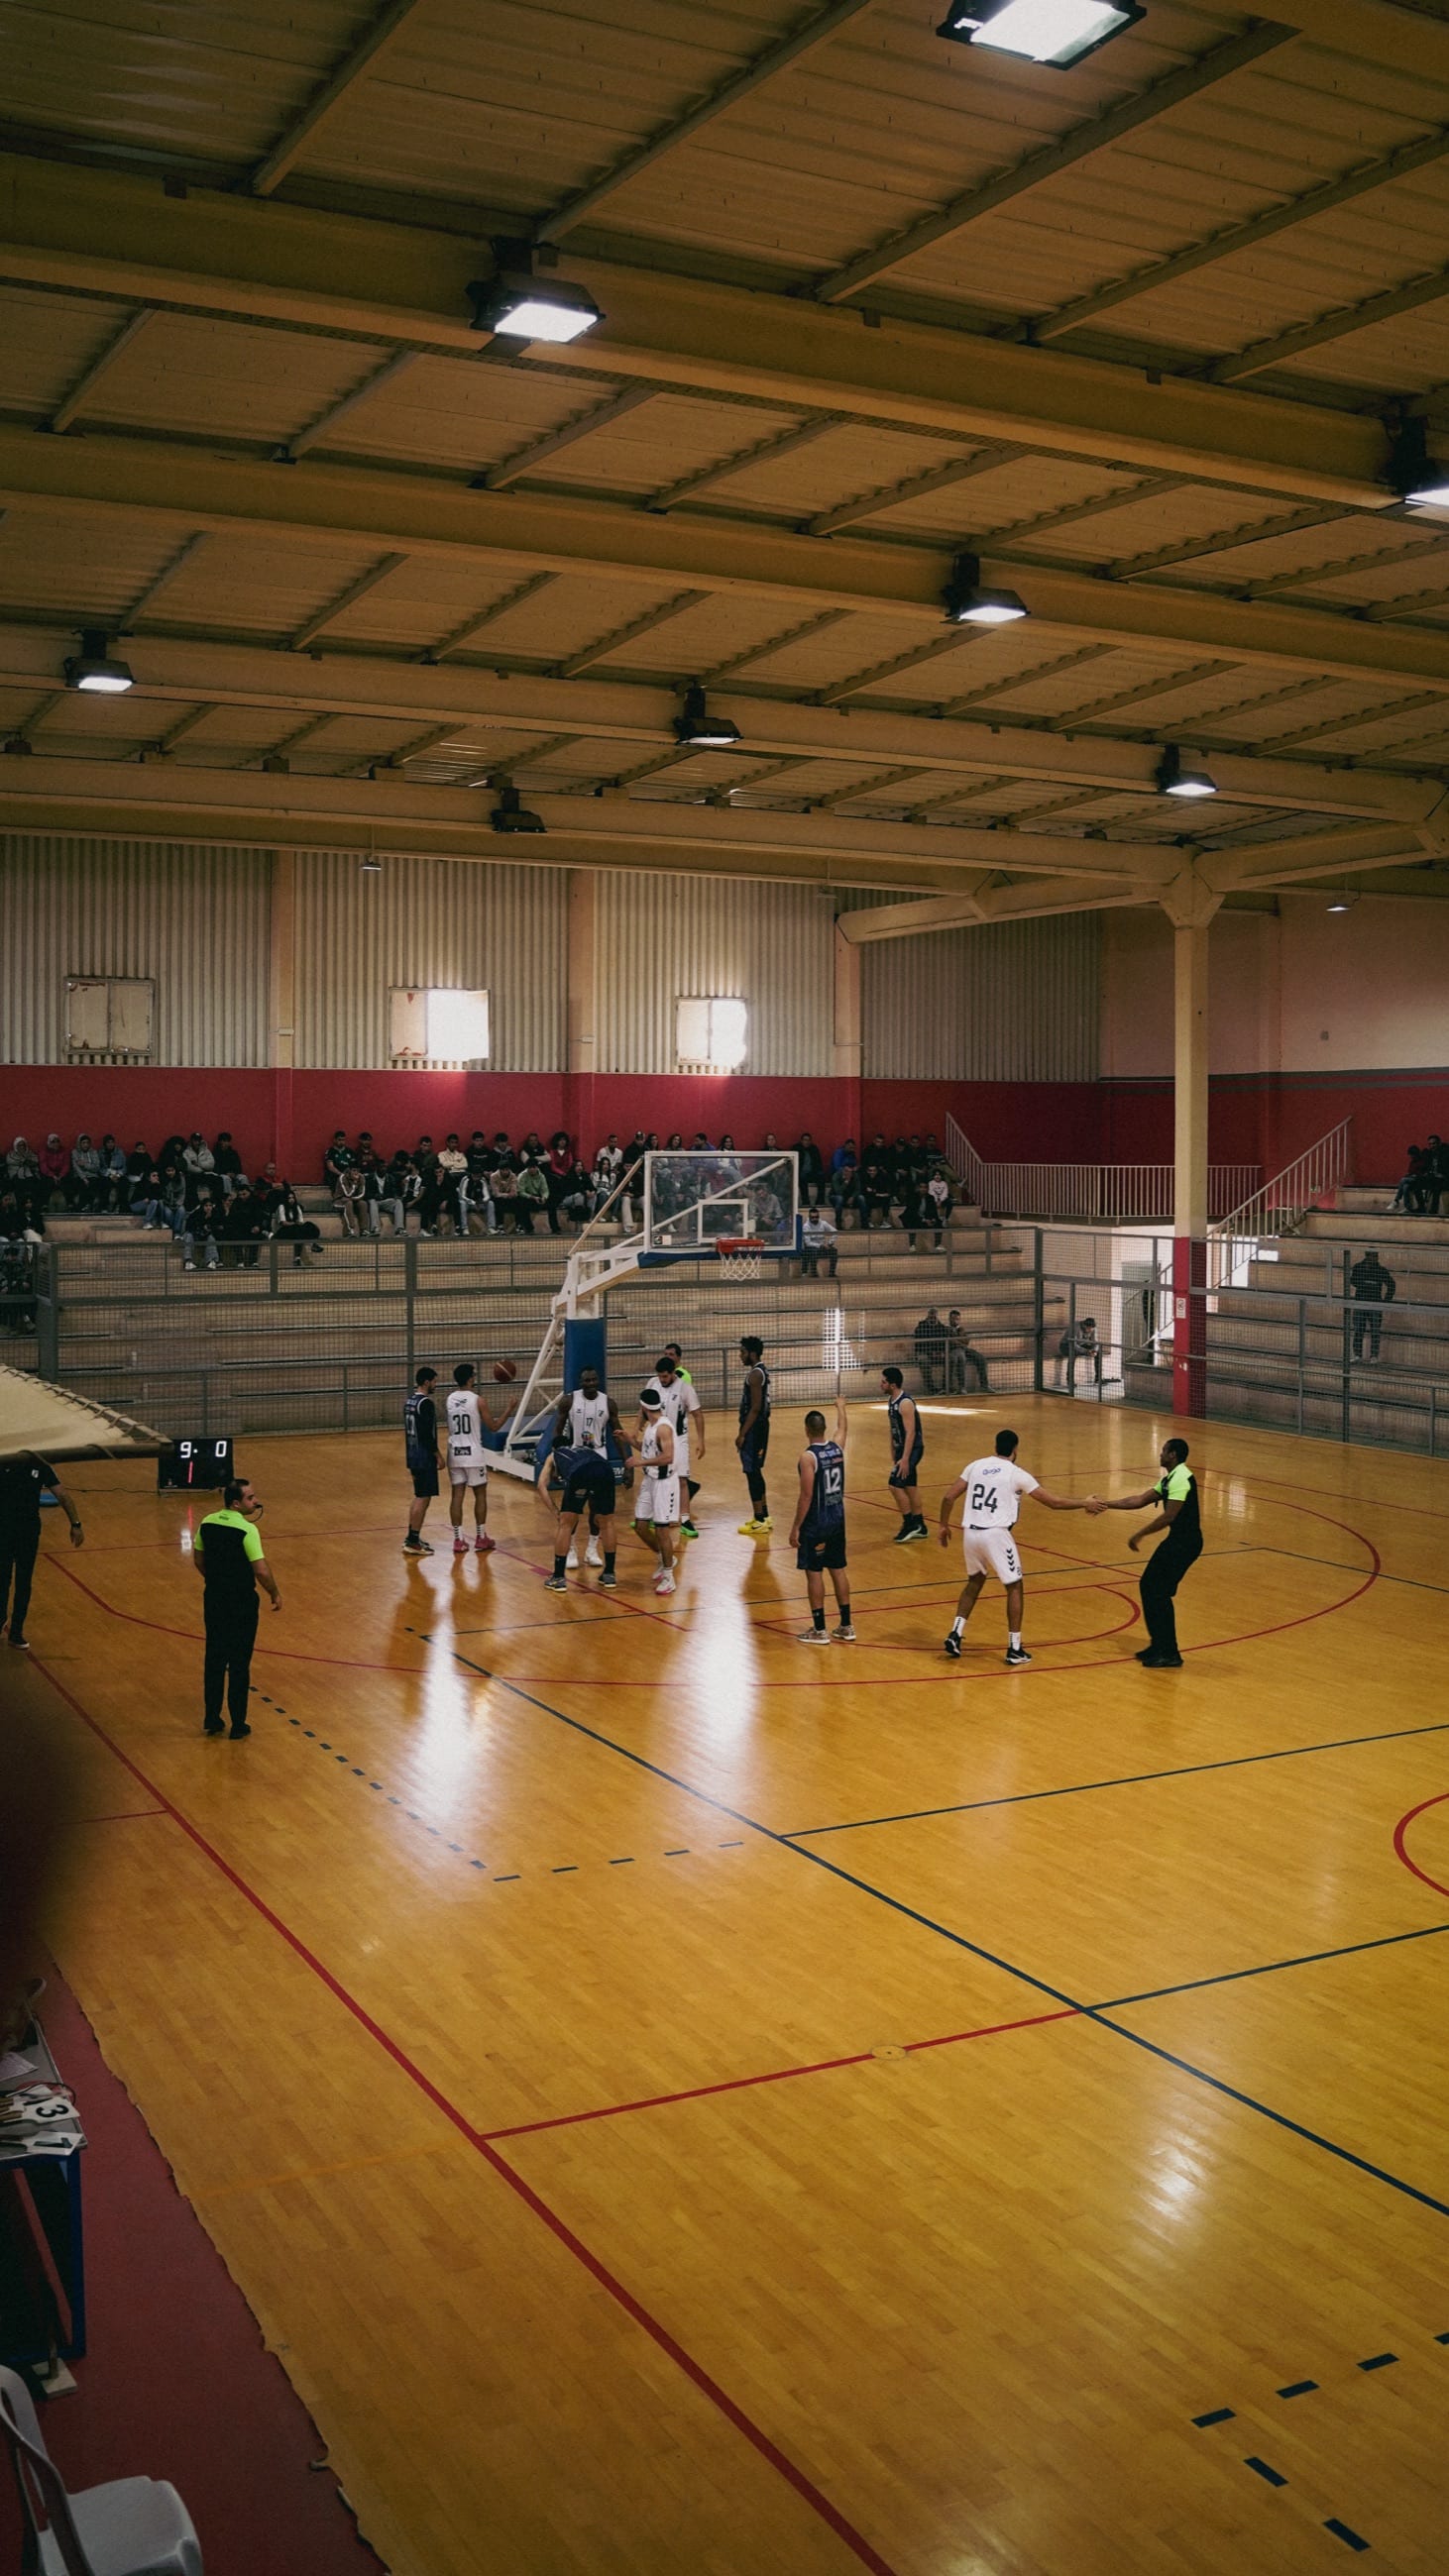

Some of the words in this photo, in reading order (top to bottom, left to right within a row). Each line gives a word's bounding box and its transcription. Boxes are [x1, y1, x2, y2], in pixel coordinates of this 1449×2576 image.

[452, 1414, 471, 1435] 30
[586, 1417, 594, 1427] 17
[215, 1440, 227, 1457] 0
[825, 1466, 840, 1494] 12
[971, 1483, 998, 1513] 24
[36, 2103, 69, 2118] 3
